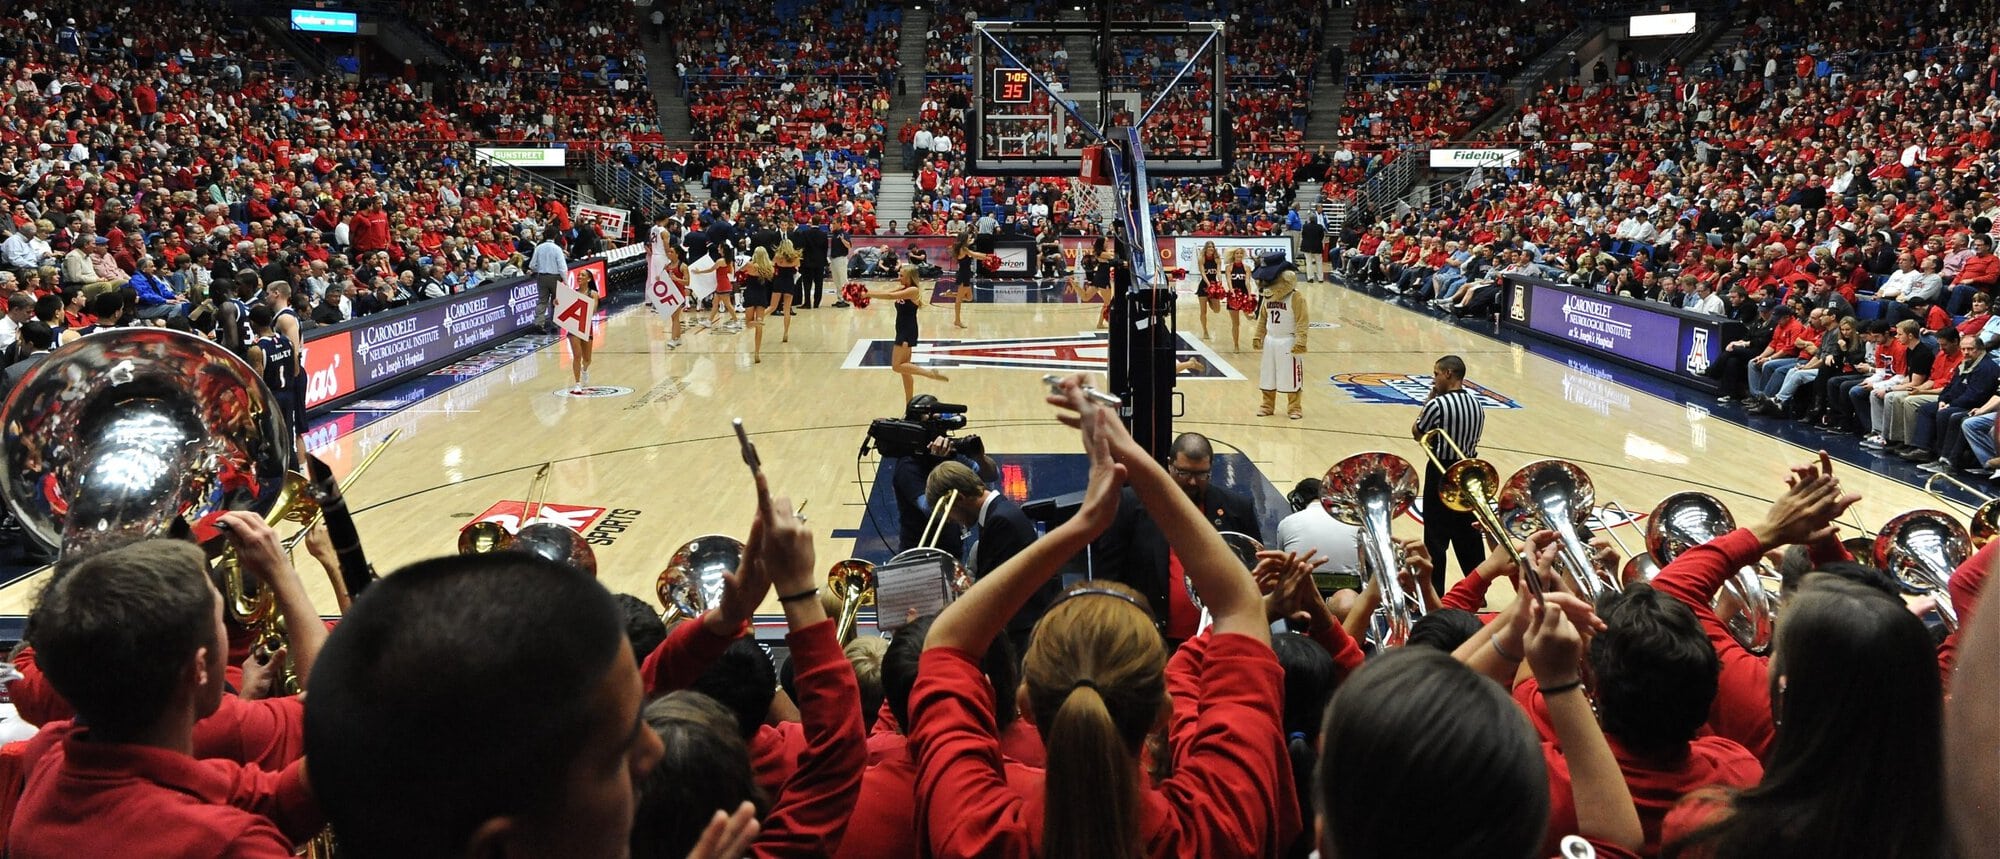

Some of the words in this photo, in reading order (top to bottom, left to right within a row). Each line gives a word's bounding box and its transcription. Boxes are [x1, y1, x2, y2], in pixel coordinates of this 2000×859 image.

[1005, 72, 1028, 82] 7:05
[1003, 84, 1023, 98] 35
[495, 151, 543, 160] SUNSTREET
[1453, 150, 1502, 162] Fidelity
[653, 280, 679, 306] OF
[450, 297, 489, 319] CARONDELET
[557, 298, 589, 334] A
[1270, 311, 1281, 324] 12
[1570, 295, 1613, 319] CARONDELET
[367, 317, 417, 345] CARONDELET
[1569, 313, 1605, 332] NEUROLOGICAL
[1605, 322, 1632, 340] INSTITUTE
[369, 338, 413, 362] NEUROLOGICAL
[413, 329, 440, 347] INSTITUTE
[1595, 332, 1614, 350] Hospital
[385, 355, 405, 375] Joseph's
[405, 347, 425, 367] Hospital
[279, 365, 286, 388] 1
[586, 508, 642, 546] SPORTS
